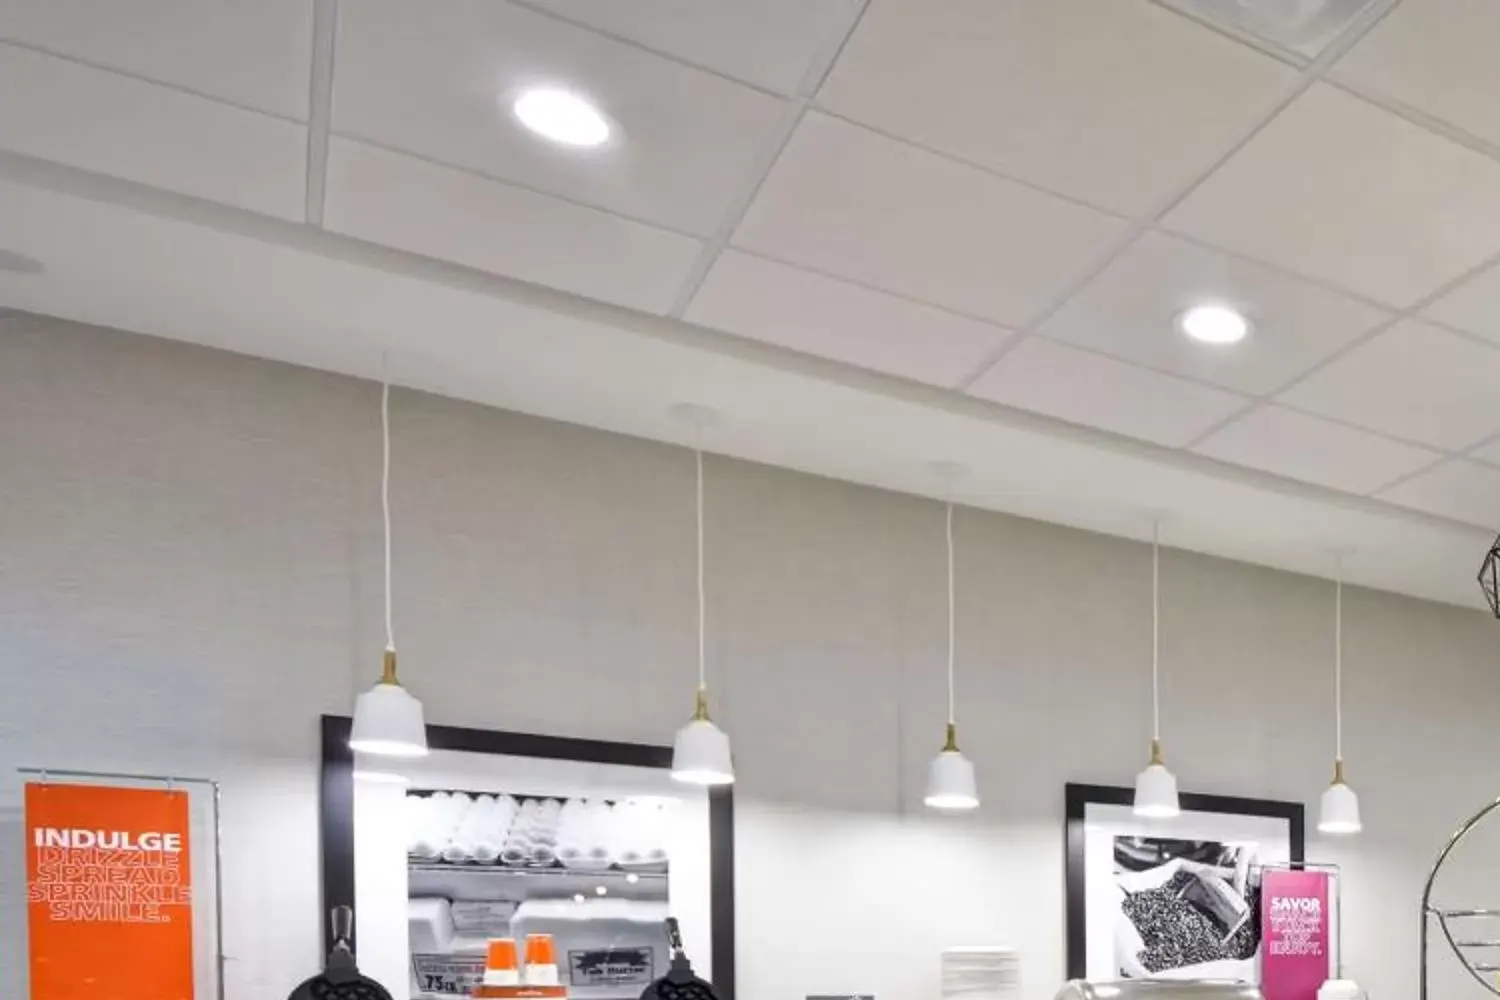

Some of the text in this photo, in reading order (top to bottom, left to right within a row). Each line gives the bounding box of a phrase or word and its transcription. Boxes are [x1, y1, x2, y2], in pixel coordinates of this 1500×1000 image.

[34, 827, 182, 851] INDULGE
[38, 847, 179, 870] DRIZZLE
[38, 863, 181, 886] SPREAD
[26, 881, 193, 905] SPRINKLE
[1271, 897, 1321, 911] SAVOR
[49, 901, 171, 922] SMILE.
